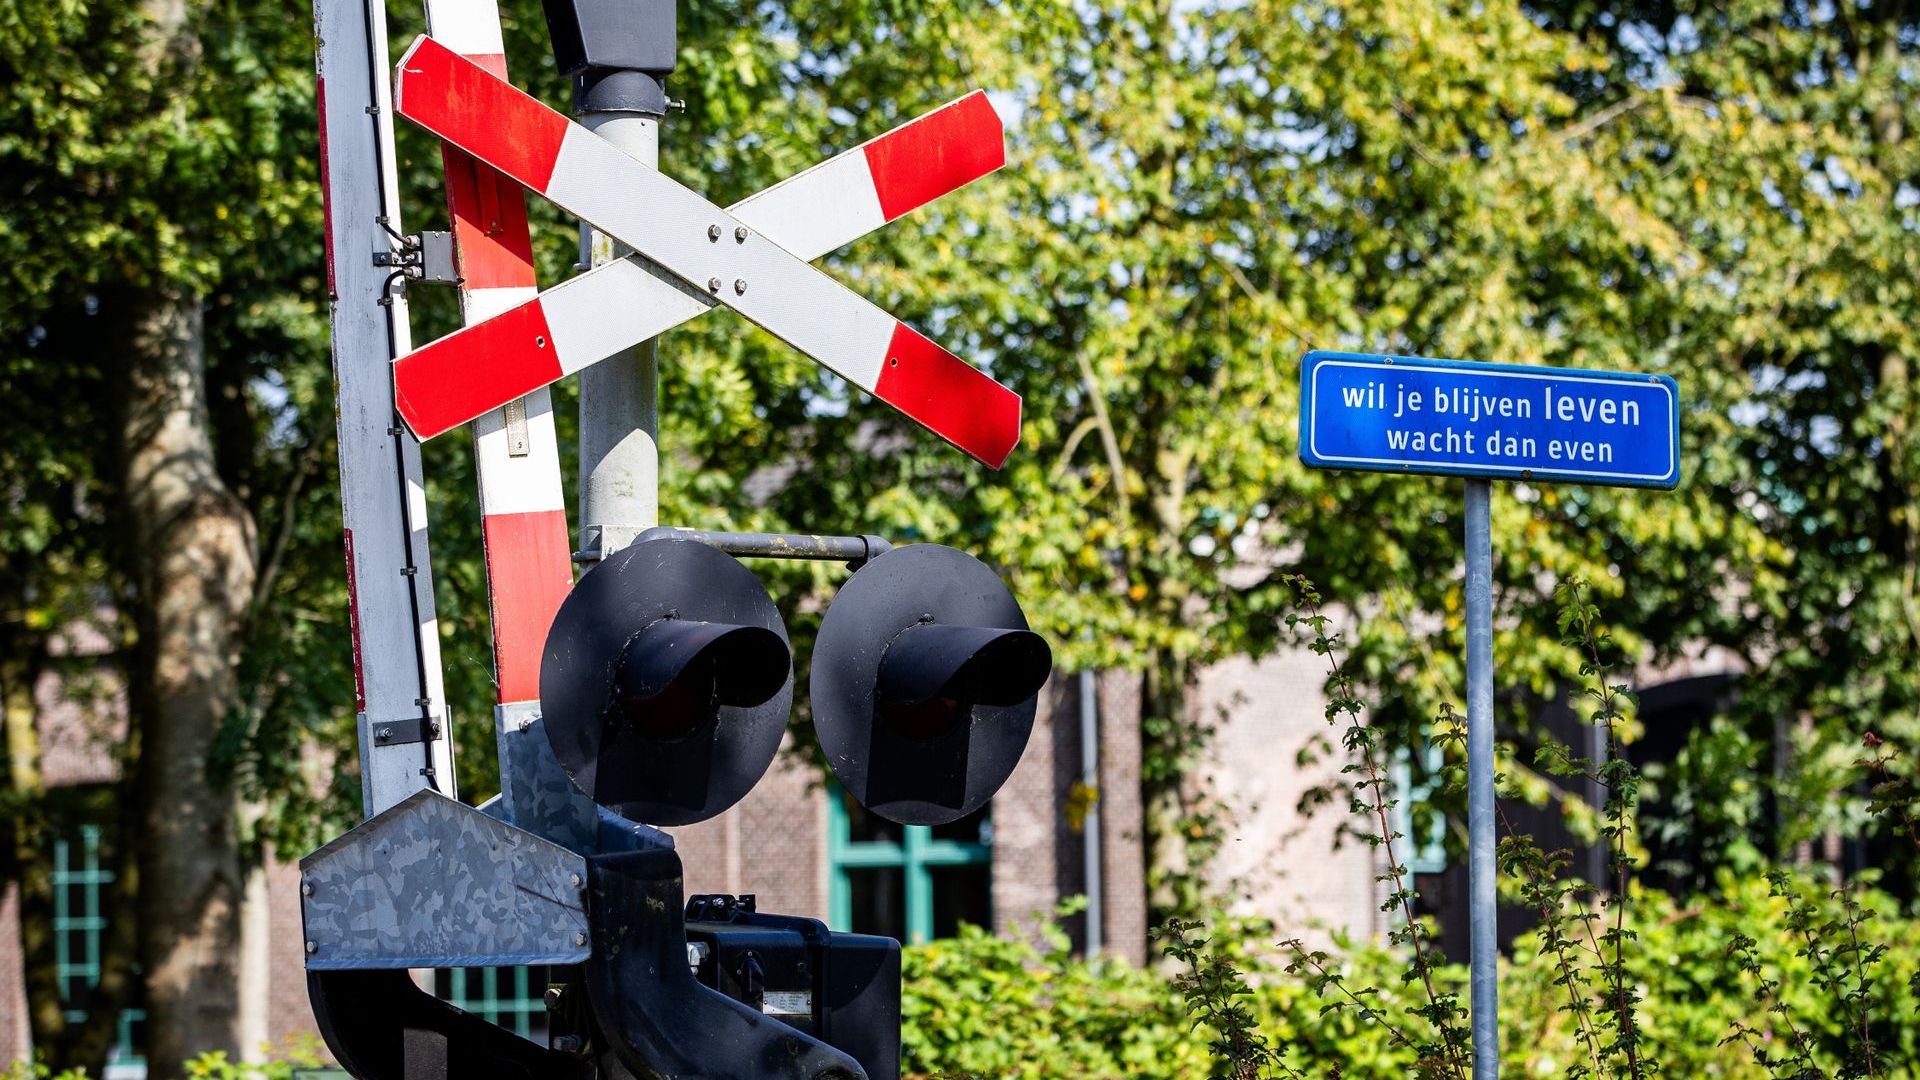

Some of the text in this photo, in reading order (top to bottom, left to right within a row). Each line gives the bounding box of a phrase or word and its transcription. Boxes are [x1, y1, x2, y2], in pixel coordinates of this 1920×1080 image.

[1342, 382, 1639, 426] wil je blijven leven
[1387, 427, 1612, 463] wacht dan even
